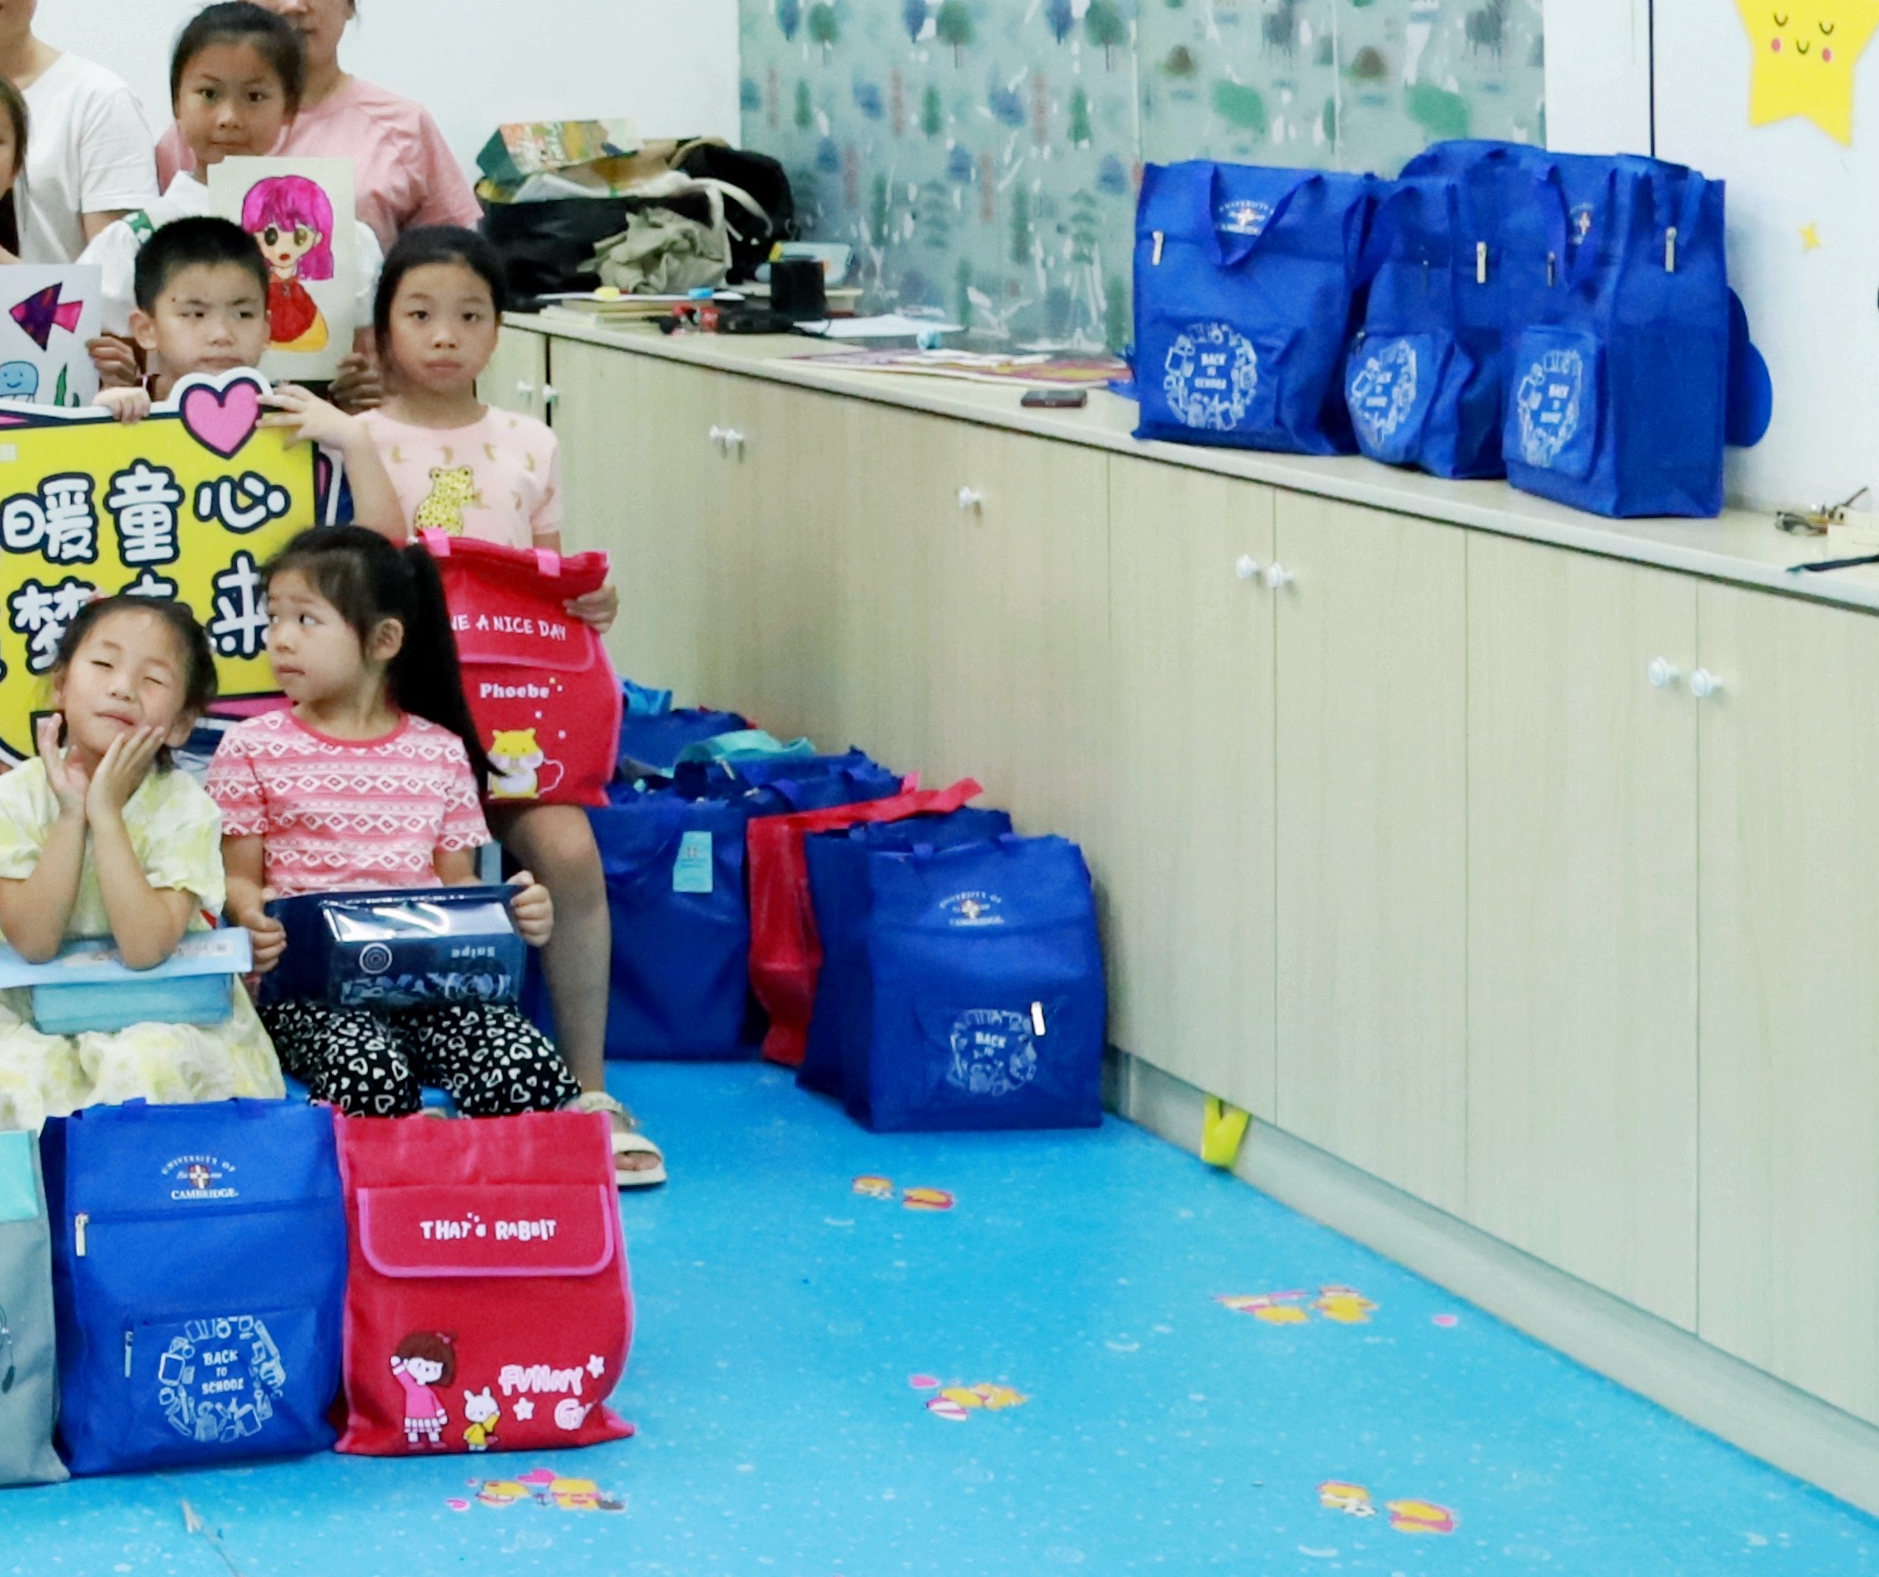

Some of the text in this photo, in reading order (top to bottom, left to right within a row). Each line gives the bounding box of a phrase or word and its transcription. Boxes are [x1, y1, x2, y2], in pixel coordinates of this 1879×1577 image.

[476, 614, 490, 632] A
[493, 615, 535, 635] NICE
[537, 619, 567, 641] DAY
[479, 683, 550, 699] Phoebe
[203, 1349, 239, 1366] BACK
[201, 1377, 245, 1395] SCHOOL
[498, 1364, 584, 1397] FUNNY
